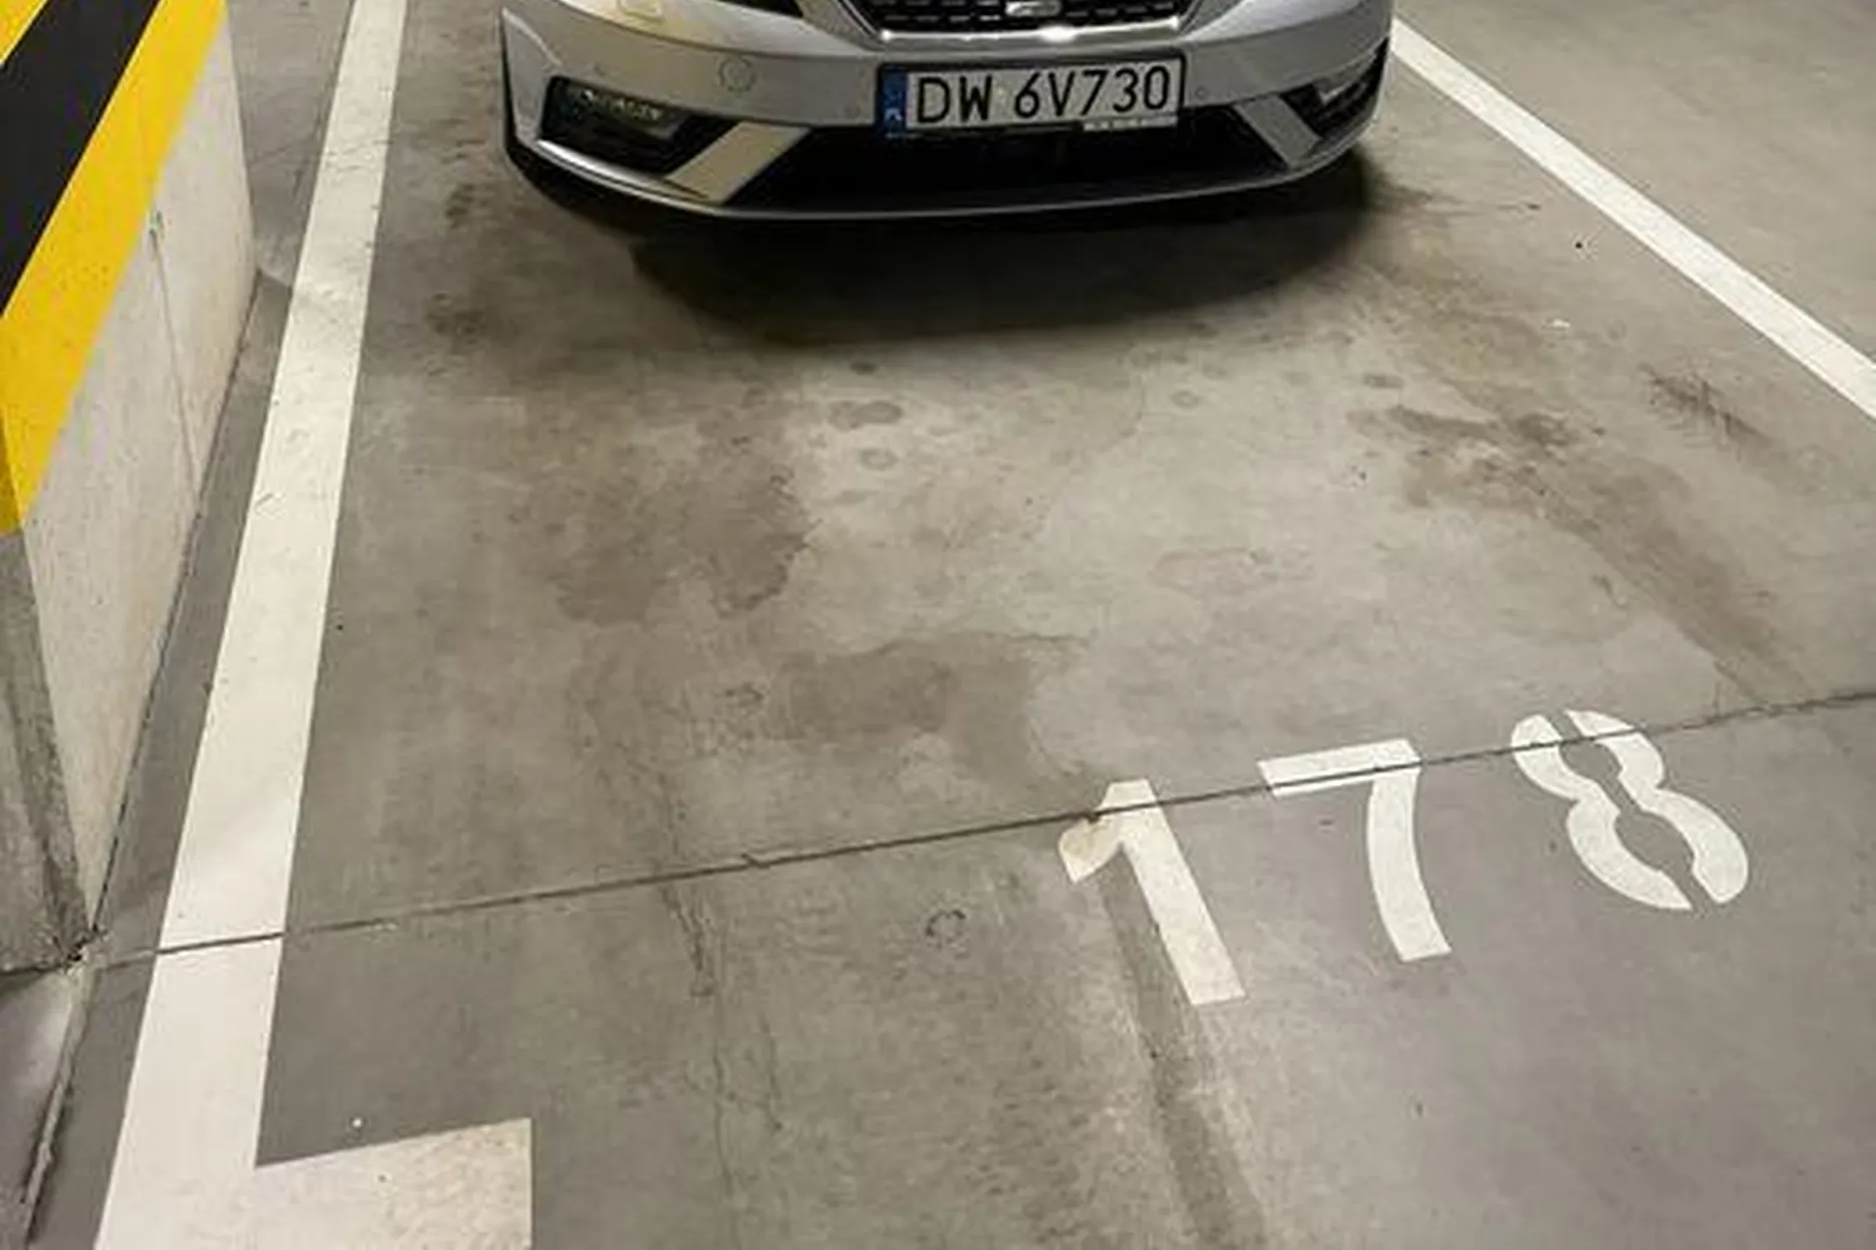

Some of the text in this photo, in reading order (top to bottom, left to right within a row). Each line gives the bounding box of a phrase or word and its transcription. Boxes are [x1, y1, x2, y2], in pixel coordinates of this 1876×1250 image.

[916, 65, 1171, 124] DW 6V730
[1057, 708, 1750, 1007] 178
